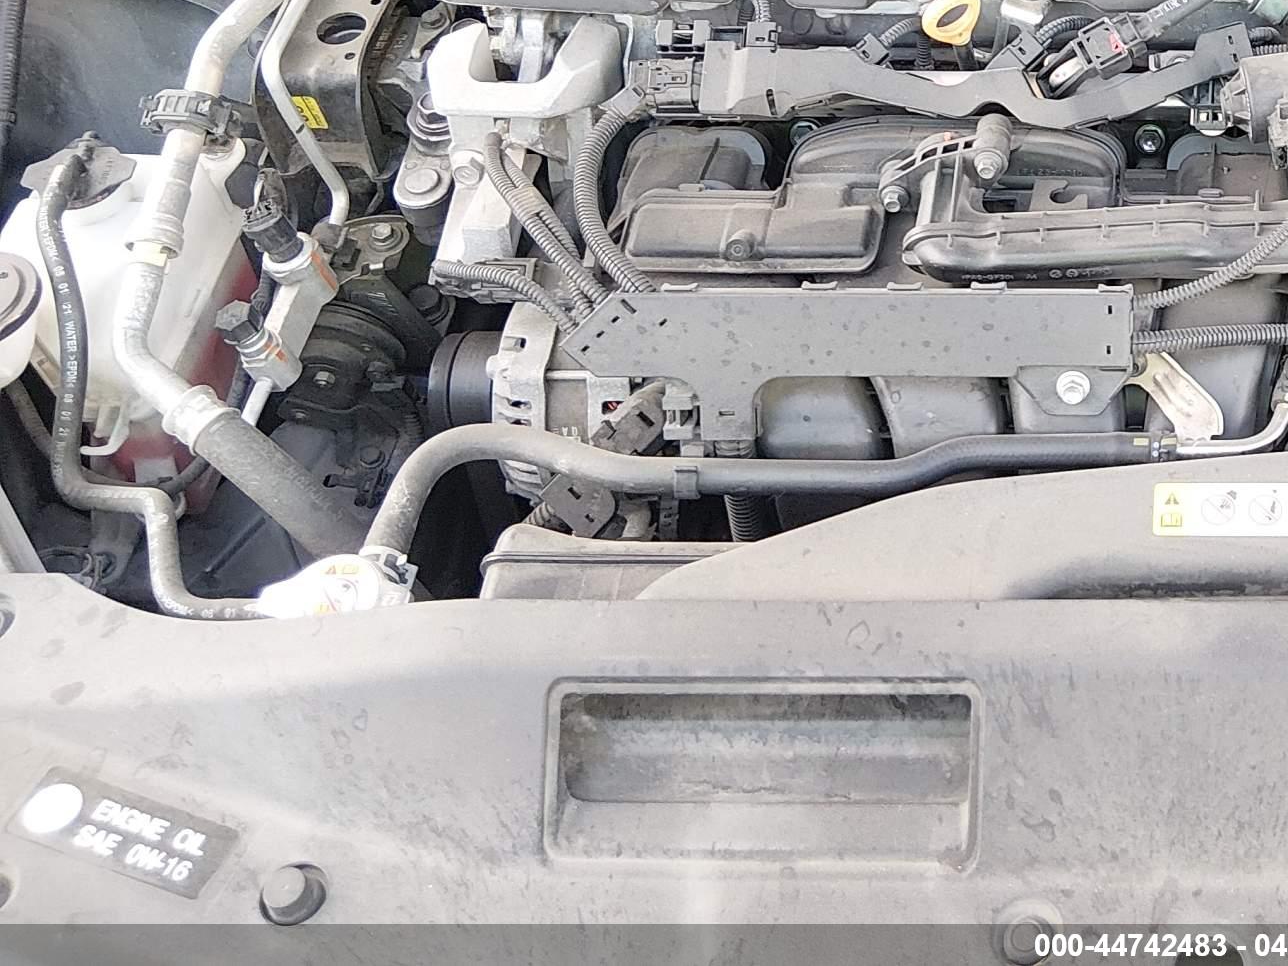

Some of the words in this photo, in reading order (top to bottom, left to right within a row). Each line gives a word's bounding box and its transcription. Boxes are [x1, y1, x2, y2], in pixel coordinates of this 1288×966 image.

[64, 321, 78, 352] WATER
[72, 824, 123, 857] SAE
[125, 843, 193, 882] 0W-16
[90, 799, 170, 841] ENGINE
[173, 828, 208, 857] OIL
